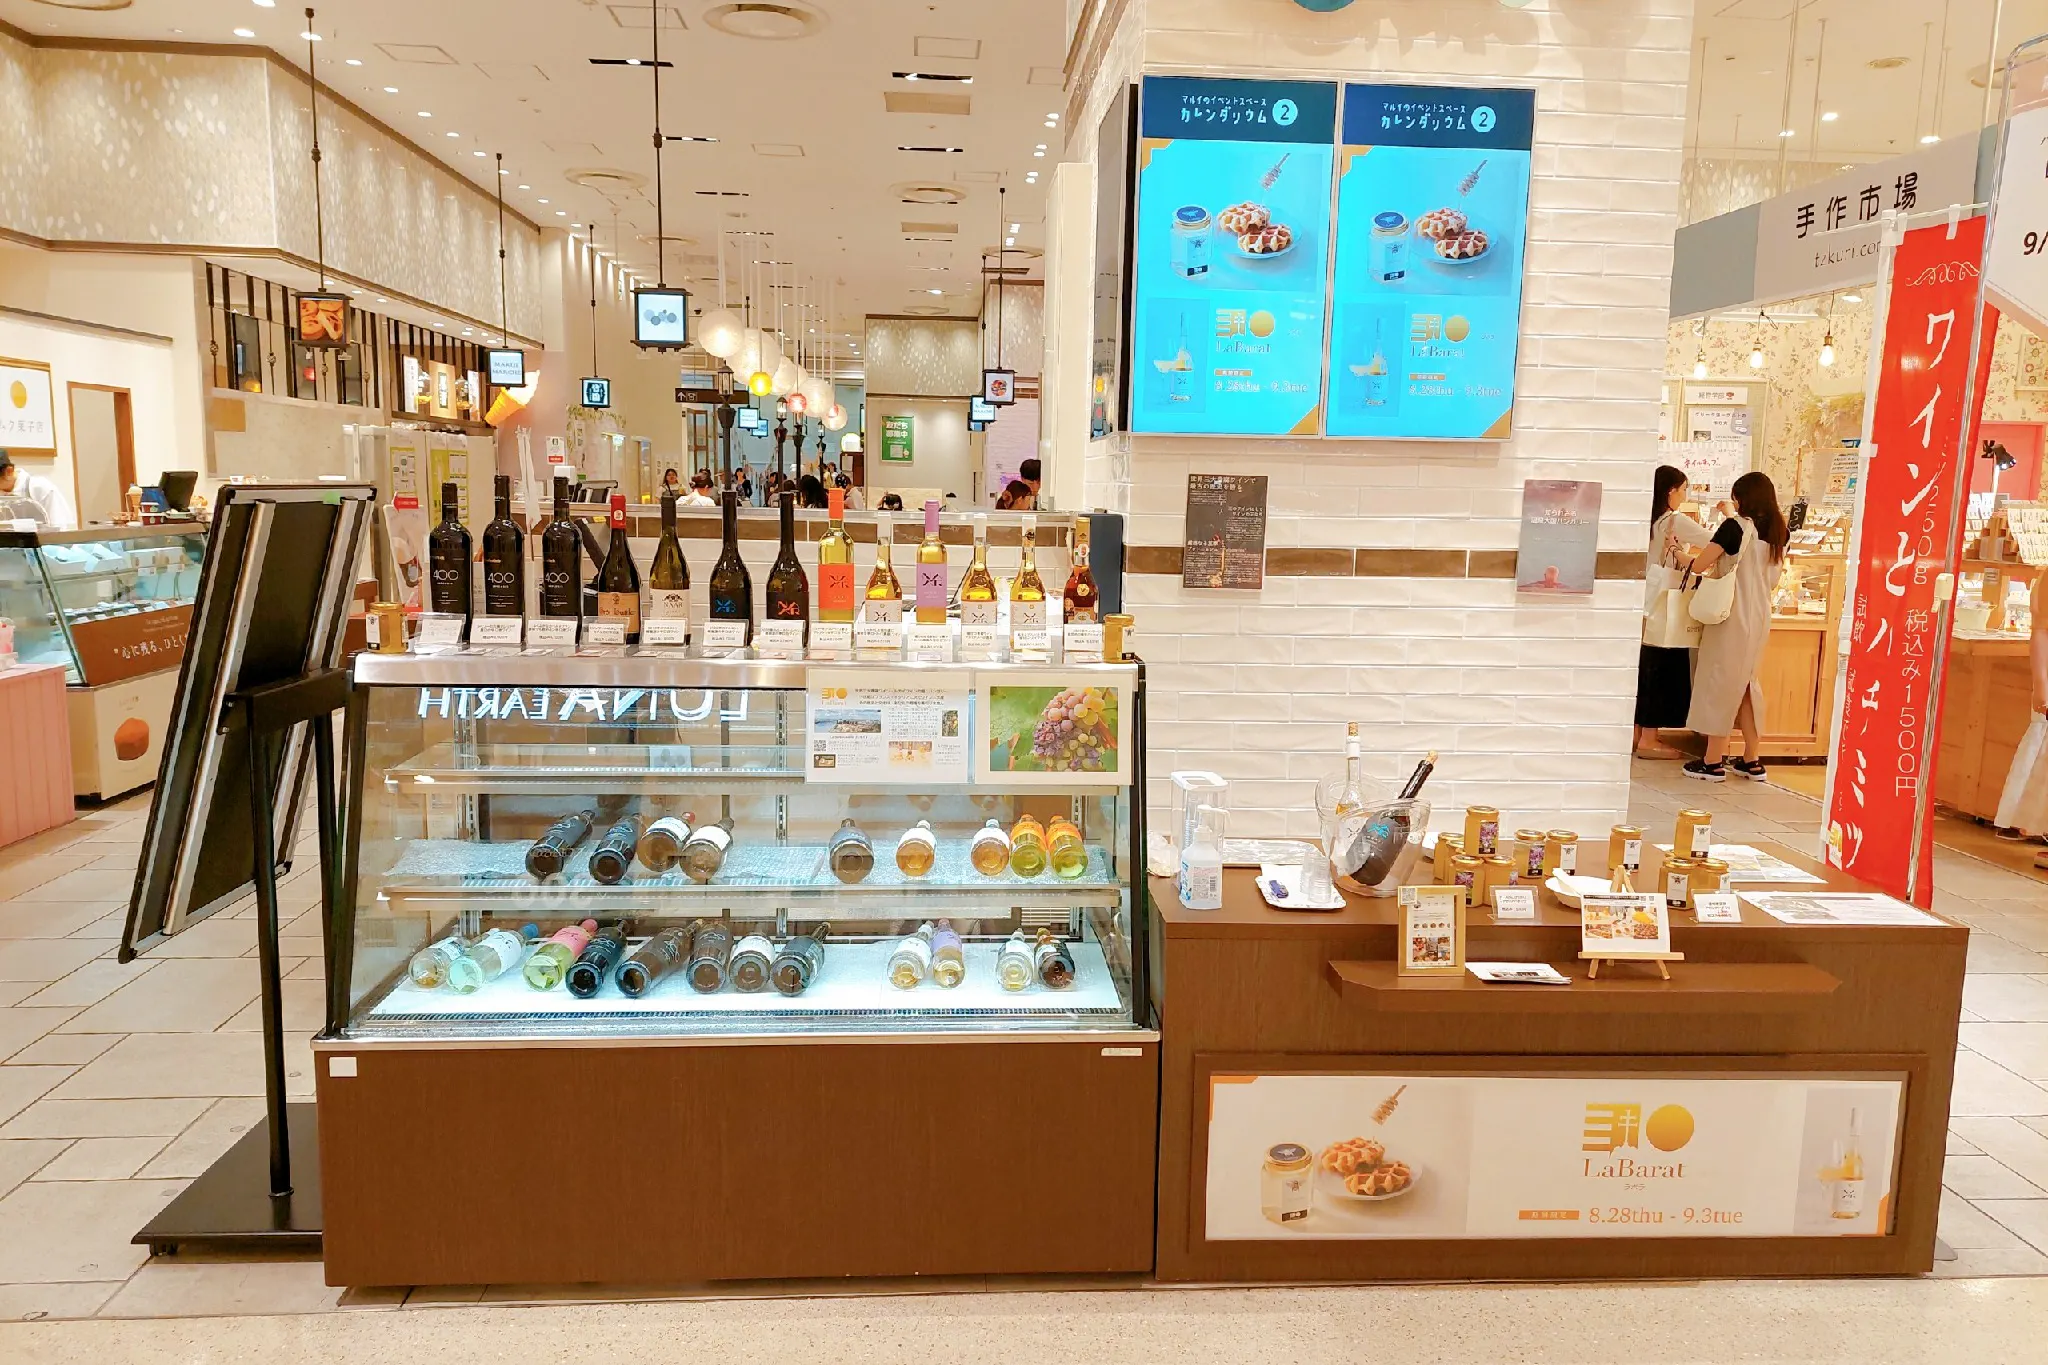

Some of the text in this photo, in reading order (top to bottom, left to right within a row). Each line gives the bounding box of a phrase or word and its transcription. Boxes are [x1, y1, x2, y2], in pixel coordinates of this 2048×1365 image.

[1182, 95, 1267, 106] マルイのイベントスペース
[1382, 102, 1466, 113] マルイのイベントスペース
[1181, 106, 1267, 124] カレンダリウム
[1381, 113, 1466, 131] カレンダリウム
[1796, 172, 1918, 239] 手作市場
[433, 570, 459, 580] 400
[488, 572, 515, 583] 400
[545, 572, 570, 583] 400
[1895, 608, 1928, 798] 税込み1500円
[1581, 1158, 1687, 1178] LaBarat
[1589, 1207, 1663, 1223] 8.28thu
[1683, 1207, 1743, 1223] 9.3tue
